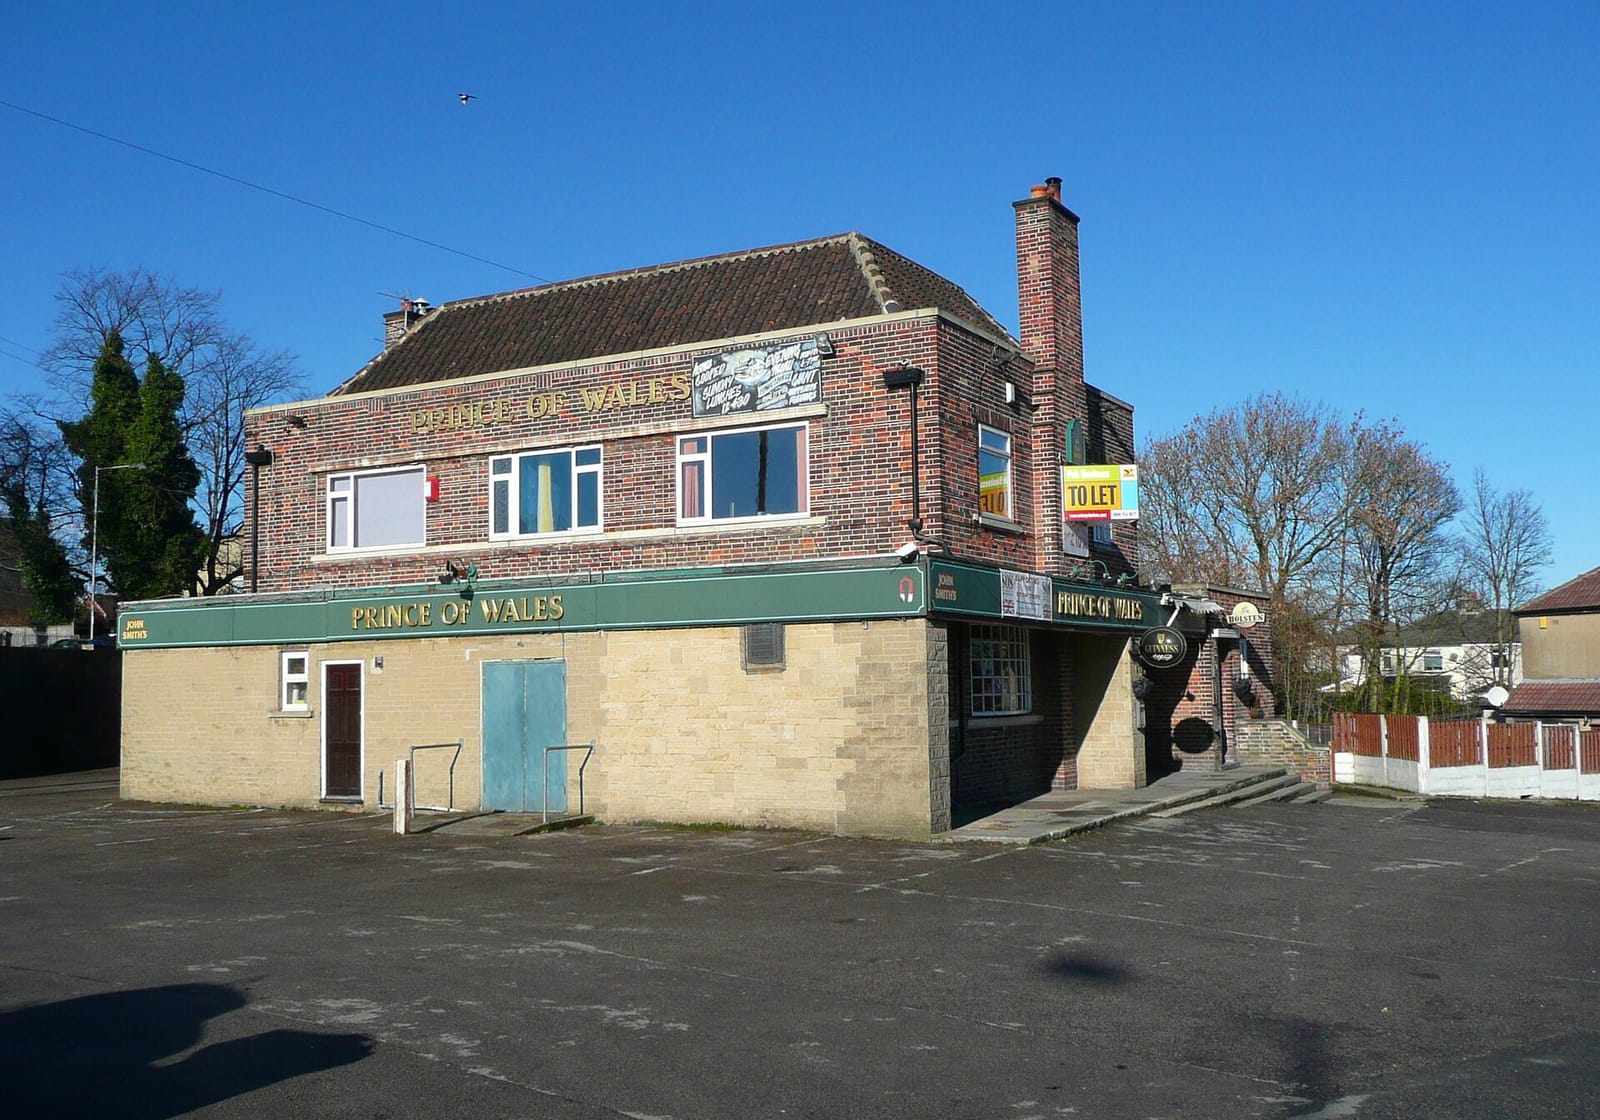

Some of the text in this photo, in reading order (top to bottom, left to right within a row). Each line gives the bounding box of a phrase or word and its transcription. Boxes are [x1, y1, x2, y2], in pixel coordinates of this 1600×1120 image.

[410, 374, 691, 435] PRINCE OF WALES
[1068, 485, 1117, 506] TO LET
[938, 573, 954, 587] JOHN
[351, 595, 564, 630] PRINCE OF WALES
[1057, 591, 1097, 617] PRINCE
[1097, 598, 1112, 618] OF
[1114, 598, 1143, 620] WALES
[126, 619, 144, 631] JOHN
[1228, 614, 1264, 623] HOLSTEN
[122, 630, 148, 640] SMITH'S
[1144, 644, 1179, 654] GUINNESS
